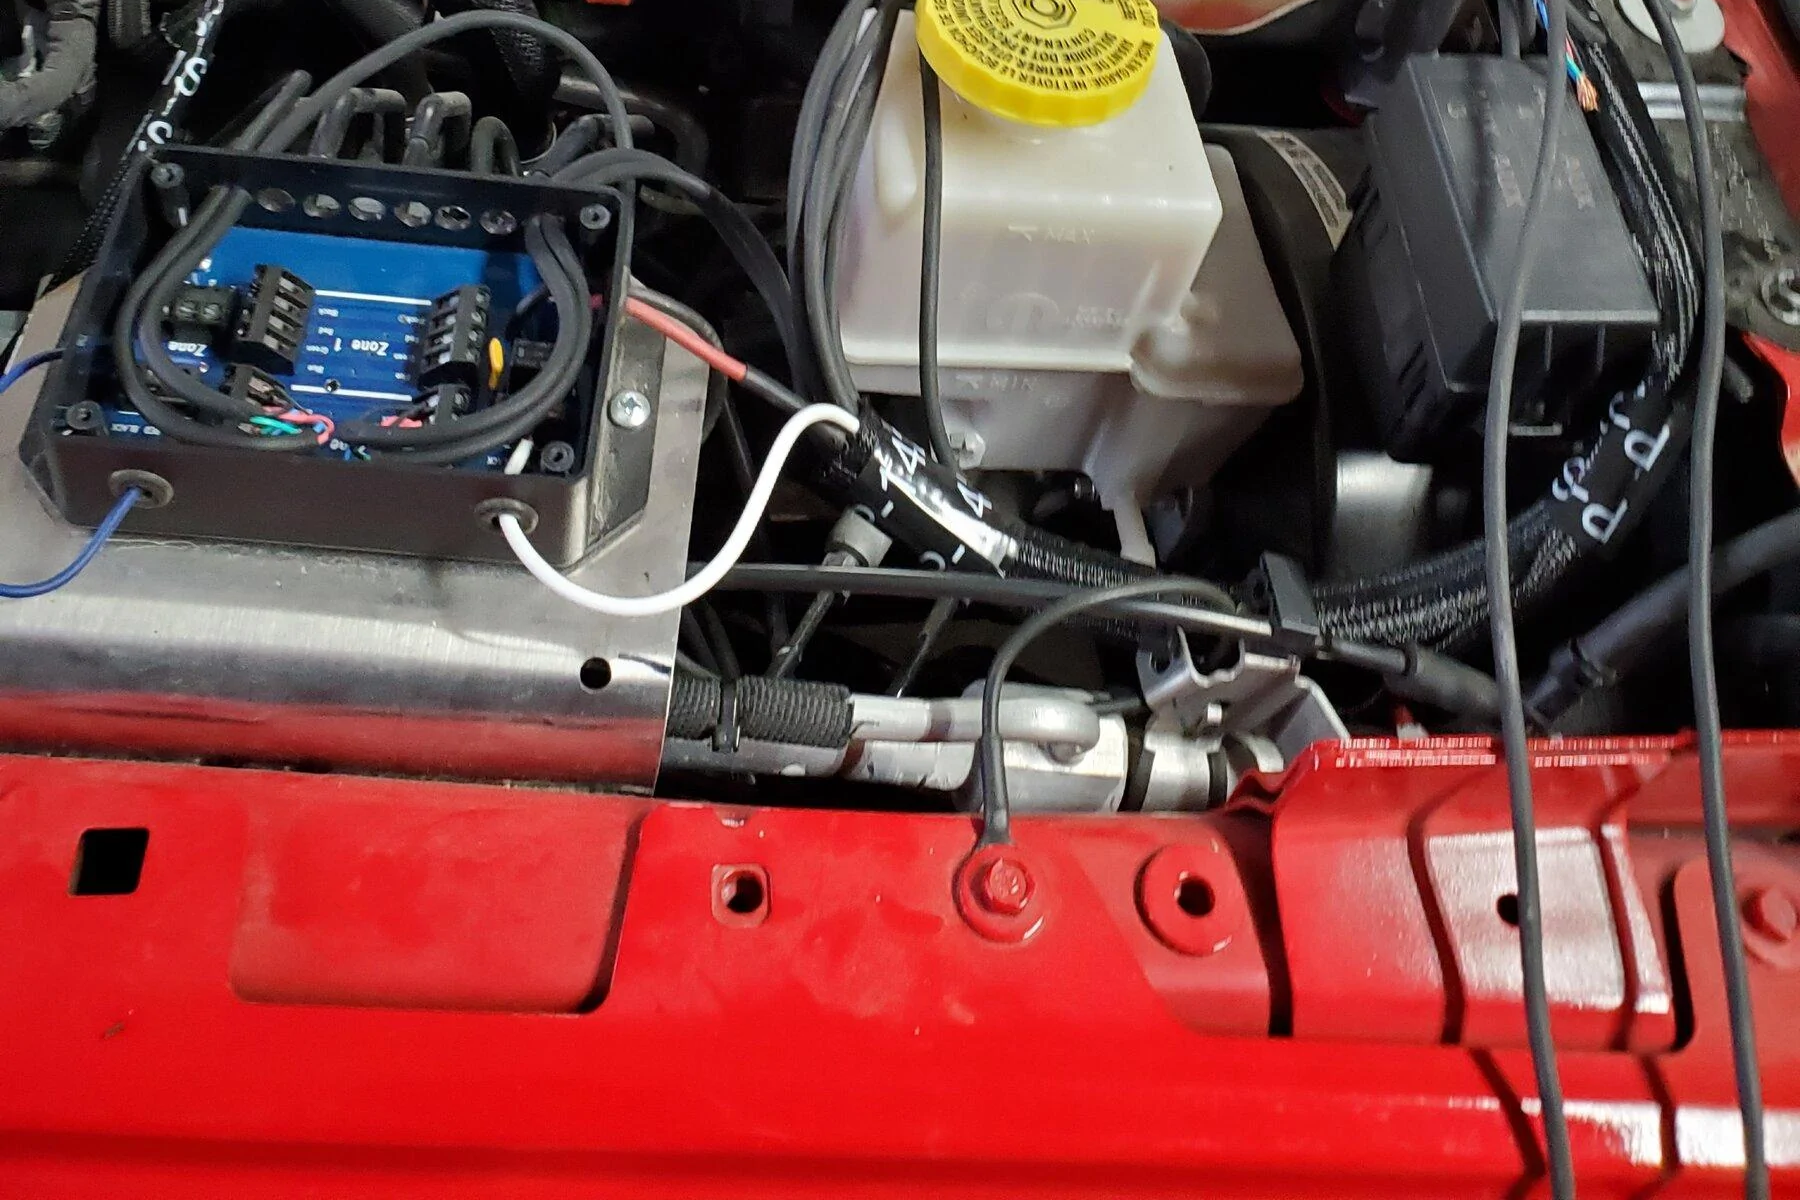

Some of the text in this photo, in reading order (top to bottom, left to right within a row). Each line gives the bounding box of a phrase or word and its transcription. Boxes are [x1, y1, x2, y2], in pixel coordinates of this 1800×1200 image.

[1013, 28, 1097, 50] CONTENANT
[1033, 50, 1059, 64] DOT
[1000, 66, 1016, 79] LE
[1076, 65, 1094, 77] LE
[1018, 73, 1088, 91] NETTOYER
[167, 340, 208, 357] Zone
[333, 337, 390, 357] Zone 1
